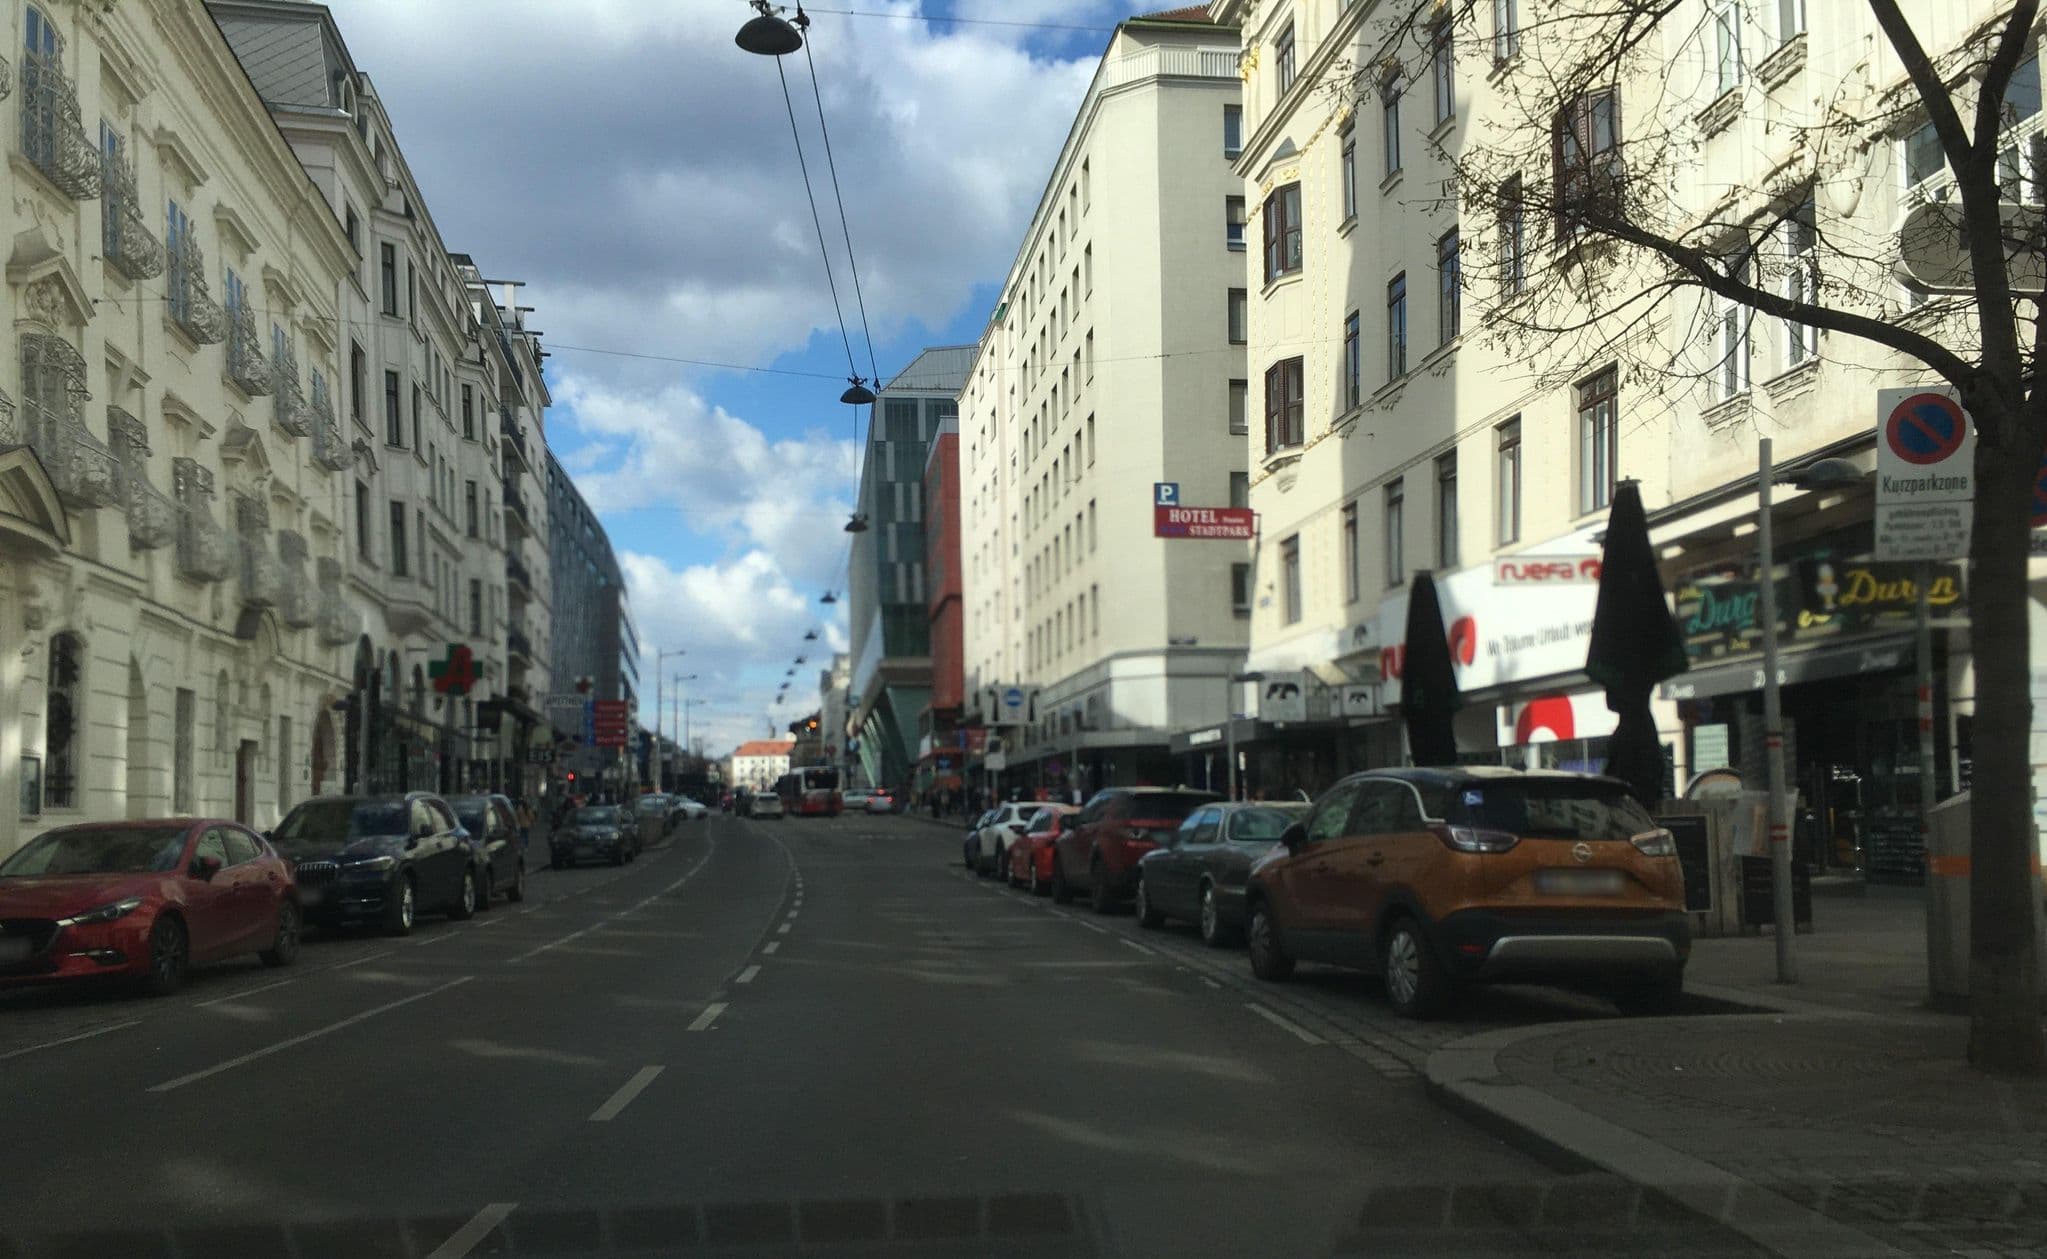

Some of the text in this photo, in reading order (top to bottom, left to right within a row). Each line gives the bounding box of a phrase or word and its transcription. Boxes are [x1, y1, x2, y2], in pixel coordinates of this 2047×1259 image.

[1882, 474, 1968, 495] Kurzparkzone
[1160, 485, 1174, 502] P
[1168, 508, 1217, 524] HOTEL
[1188, 525, 1250, 537] STADTPARK
[1500, 562, 1574, 582] ruefa
